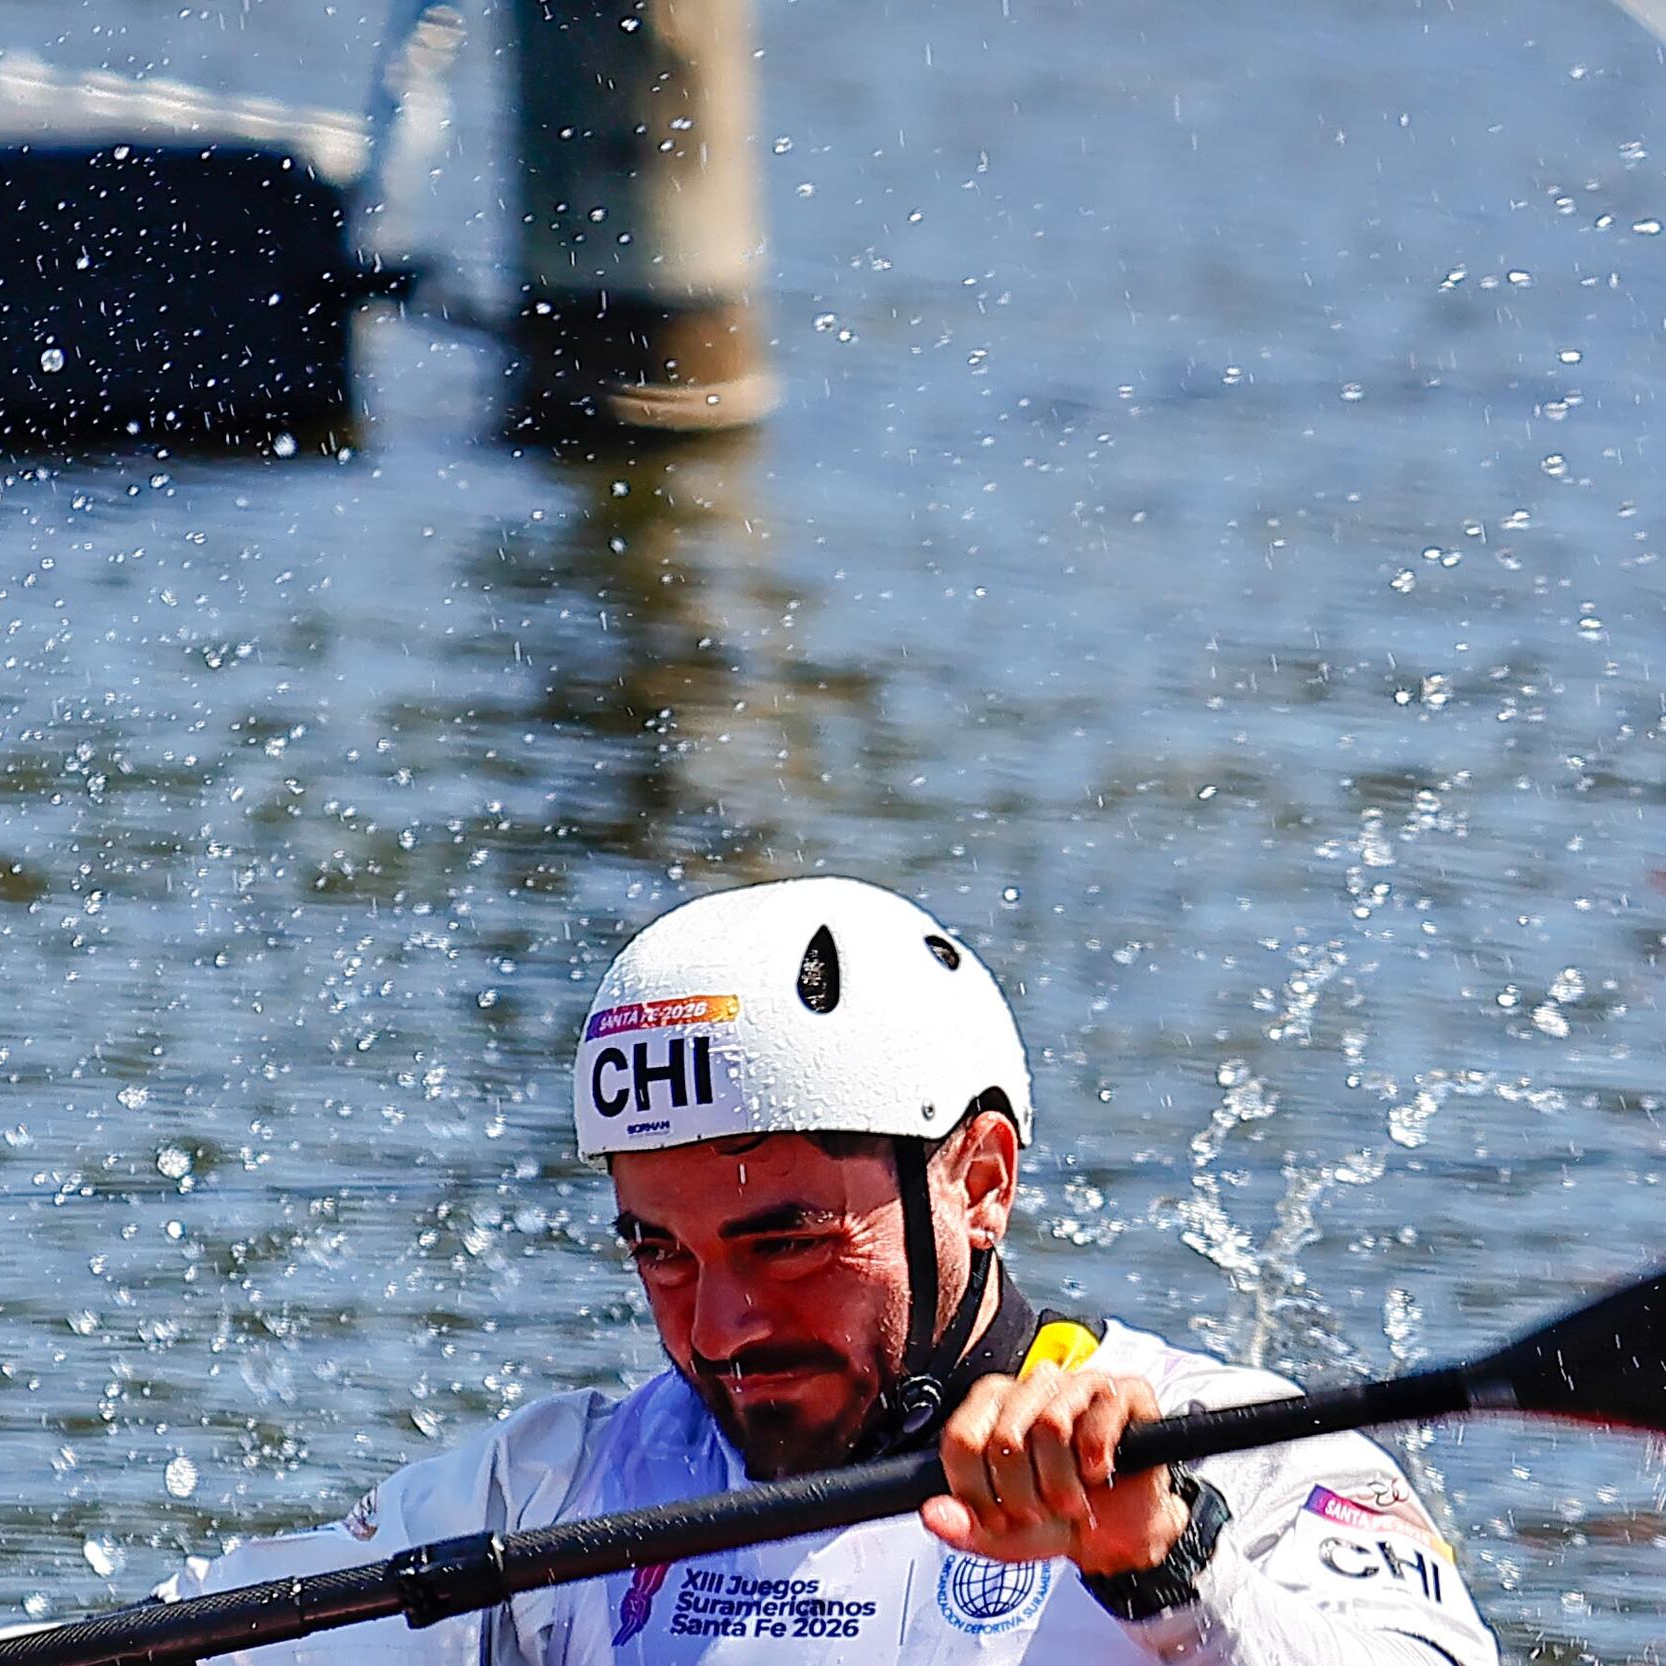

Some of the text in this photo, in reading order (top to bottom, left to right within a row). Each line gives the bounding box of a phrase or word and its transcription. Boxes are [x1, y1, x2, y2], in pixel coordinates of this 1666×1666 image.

[661, 1002, 707, 1020] 2026
[592, 1036, 713, 1118] CHI
[1324, 1500, 1369, 1529] SANTA
[1318, 1536, 1442, 1604] CHI
[681, 1568, 819, 1600] XIII Juegos
[675, 1591, 877, 1617] Suramericanos
[670, 1614, 860, 1638] Santa Fe 2026
[964, 1615, 1026, 1635] DEPORTIVA
